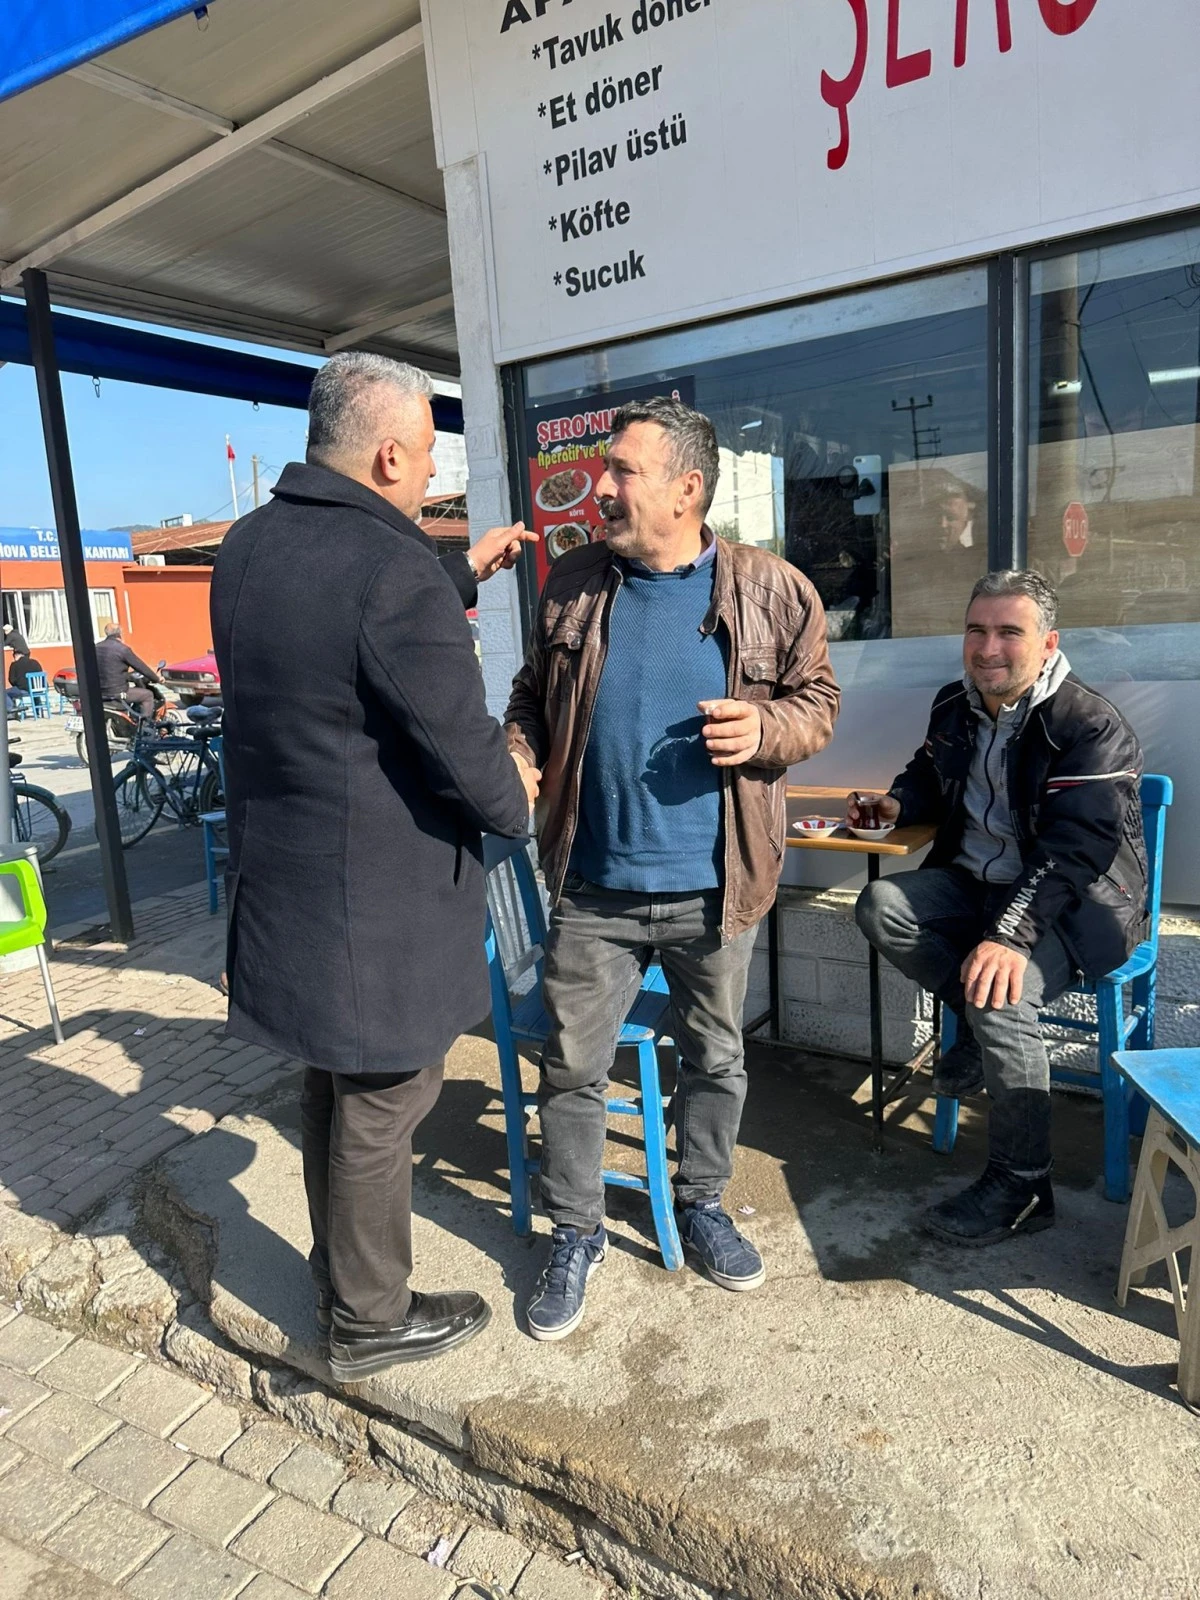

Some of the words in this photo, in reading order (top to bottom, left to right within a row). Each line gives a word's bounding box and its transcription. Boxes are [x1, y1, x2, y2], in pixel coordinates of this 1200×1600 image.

[585, 64, 663, 116] döner
[626, 112, 688, 162] üstü
[85, 547, 129, 559] KANTARI
[997, 887, 1037, 937] YAMAHA
